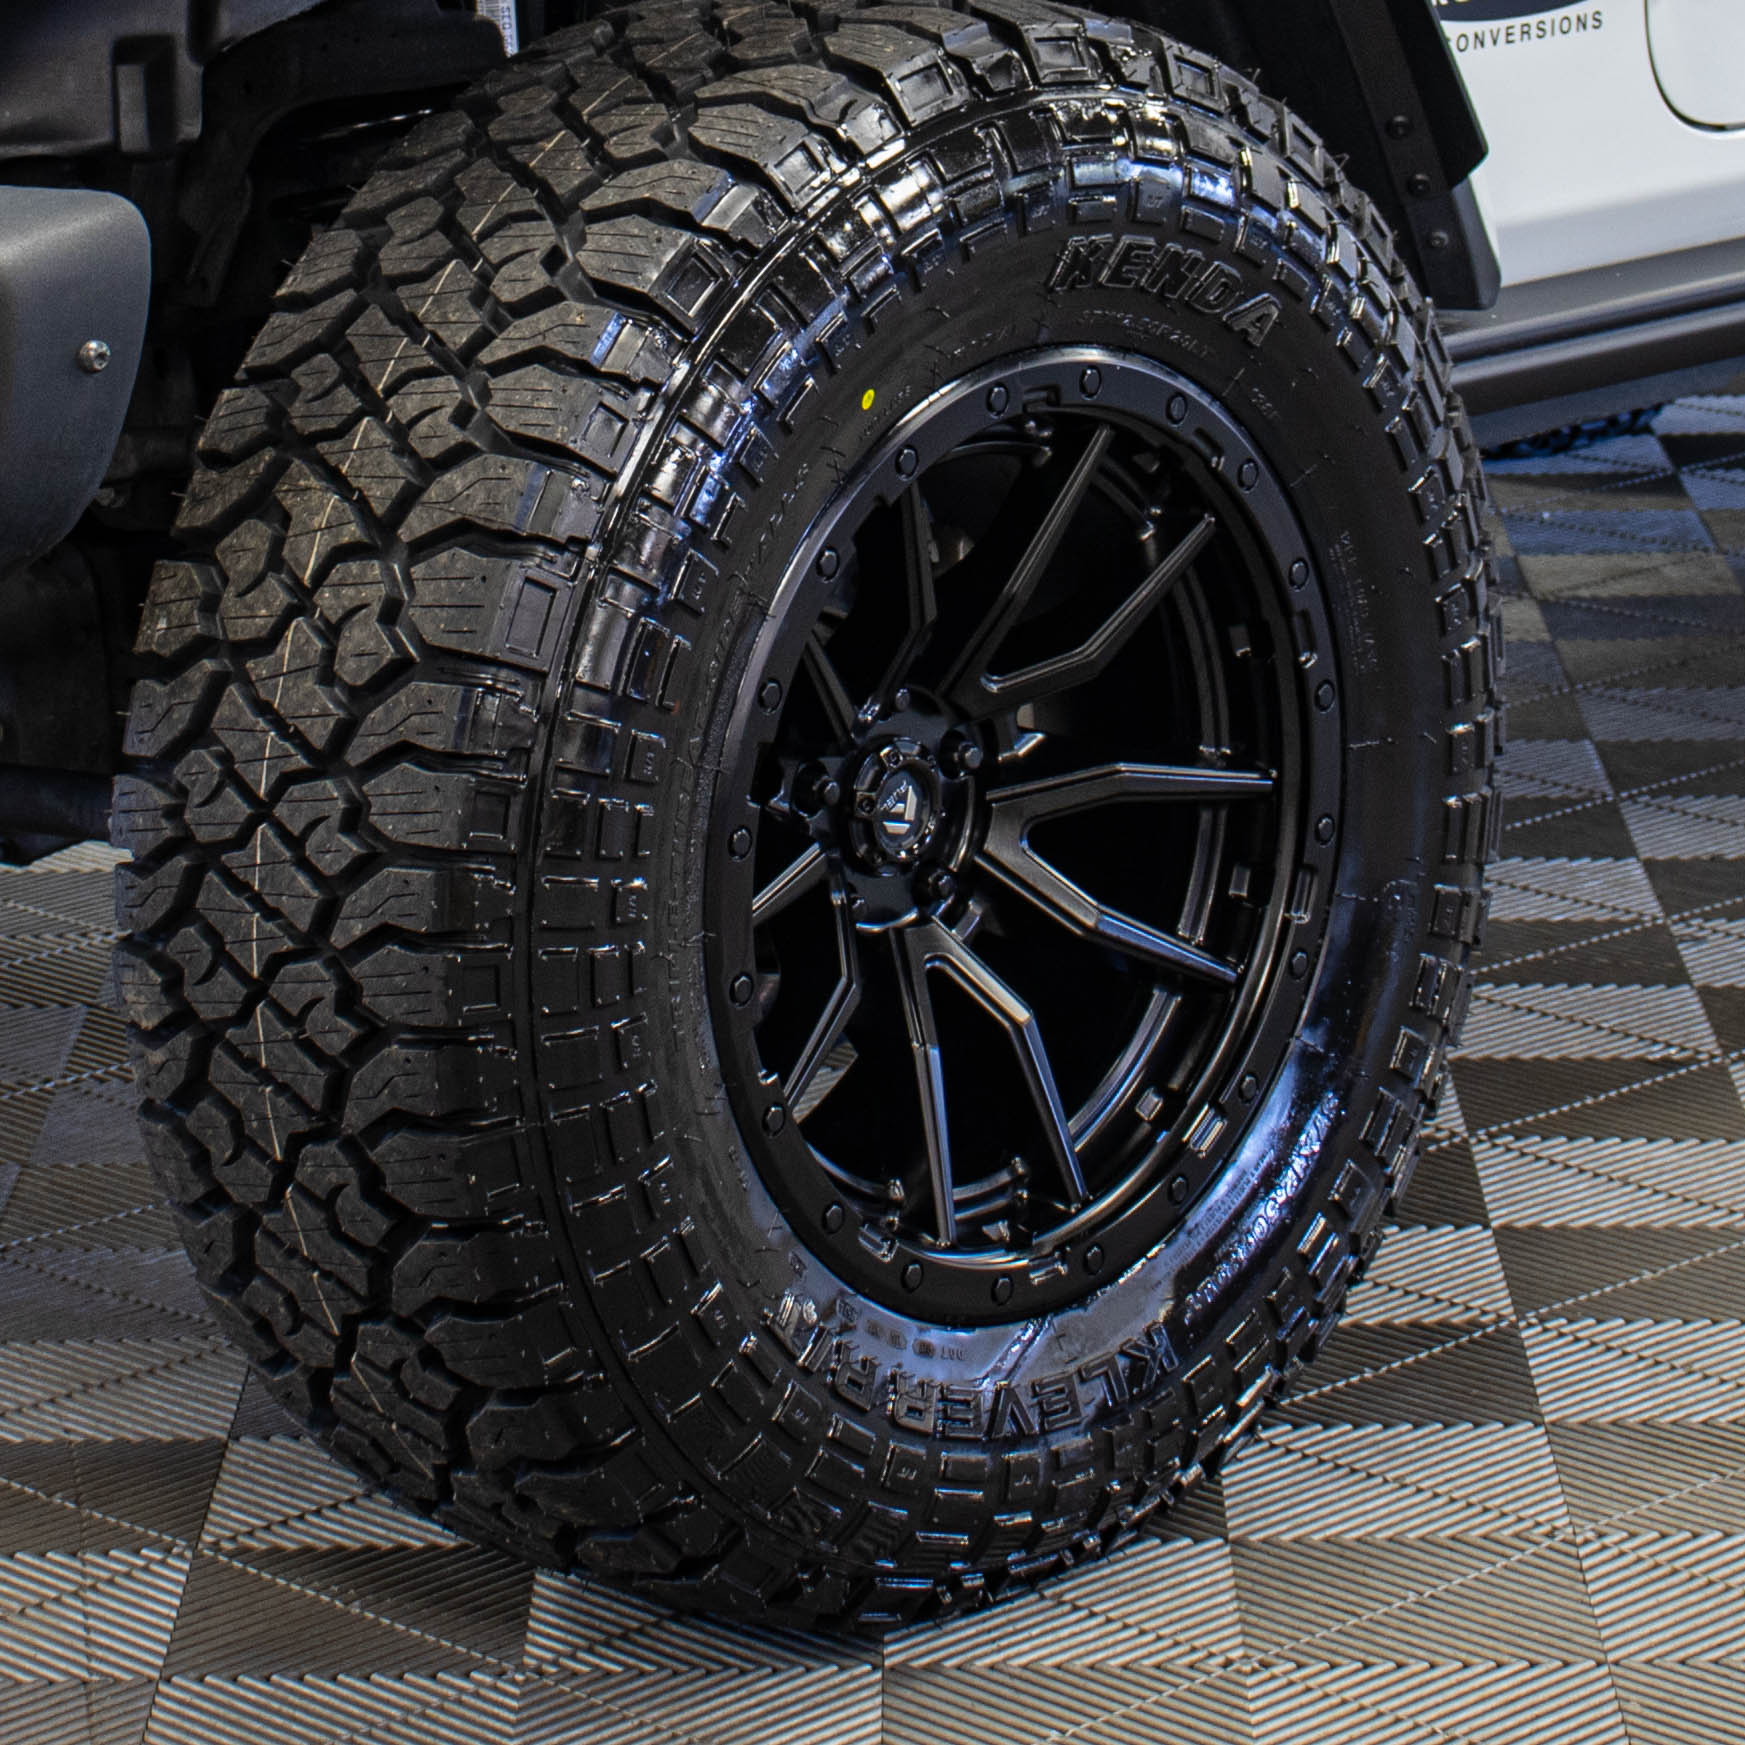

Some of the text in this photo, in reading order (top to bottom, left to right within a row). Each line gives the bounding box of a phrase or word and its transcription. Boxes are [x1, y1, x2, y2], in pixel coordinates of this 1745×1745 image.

[1446, 10, 1604, 53] ONVERSIONS
[1042, 232, 1283, 348] KENDA
[886, 1320, 1180, 1441] KLEVER
